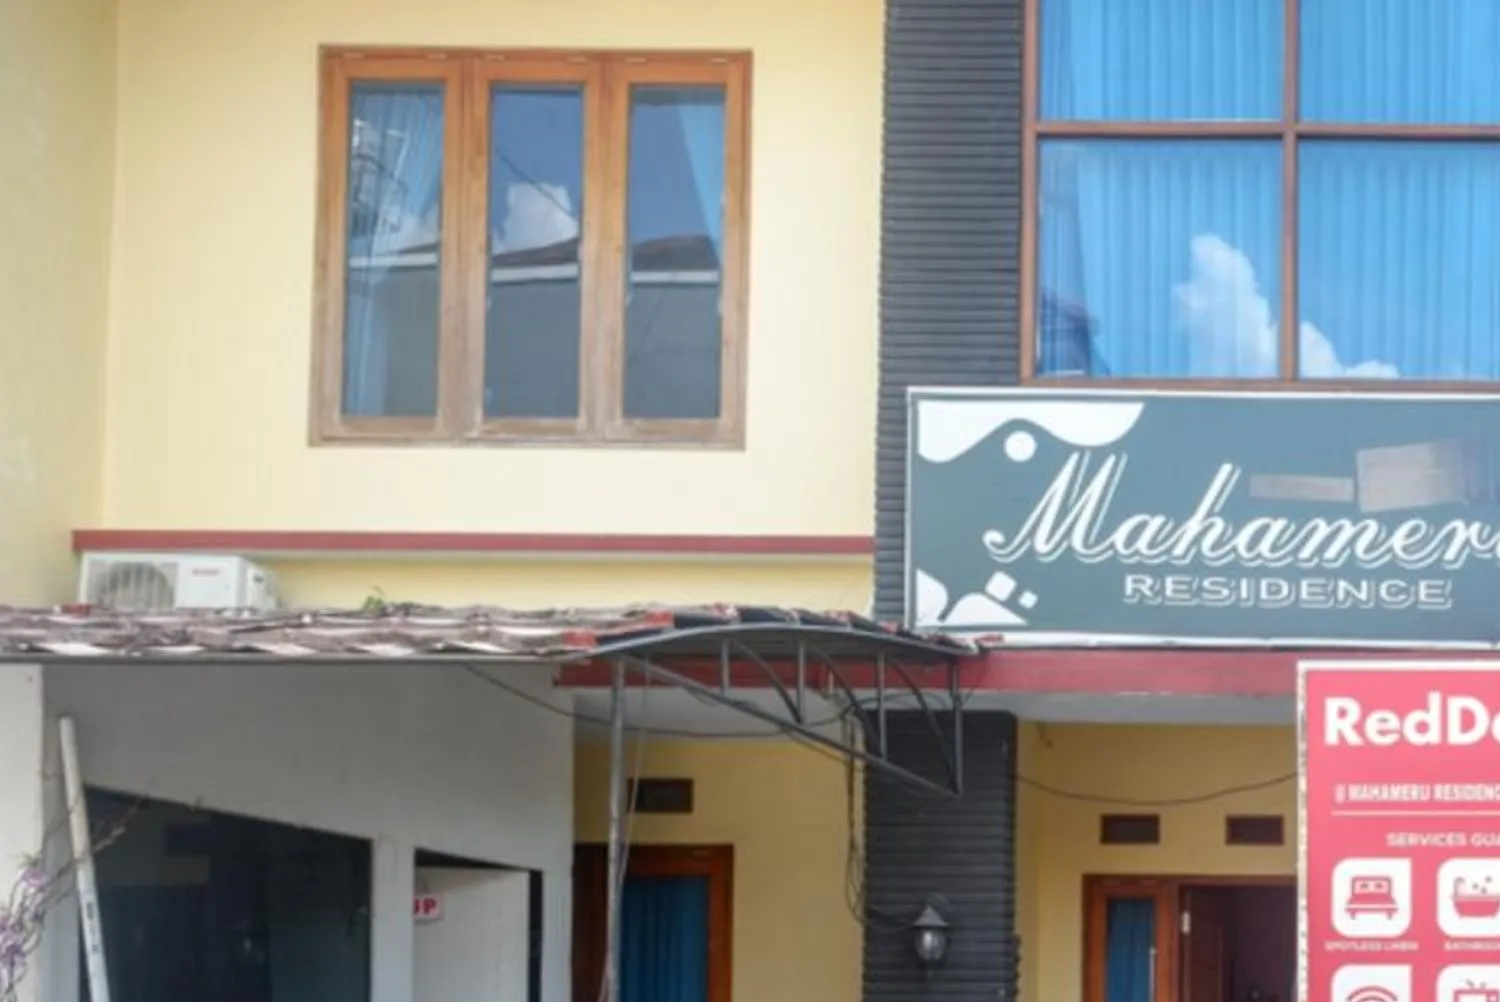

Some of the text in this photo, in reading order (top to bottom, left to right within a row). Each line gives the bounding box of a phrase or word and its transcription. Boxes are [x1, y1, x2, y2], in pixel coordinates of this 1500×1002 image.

[1124, 573, 1452, 609] RESIDENCE
[1348, 783, 1432, 802] MAHAMERU
[1386, 832, 1467, 848] SERVICES
